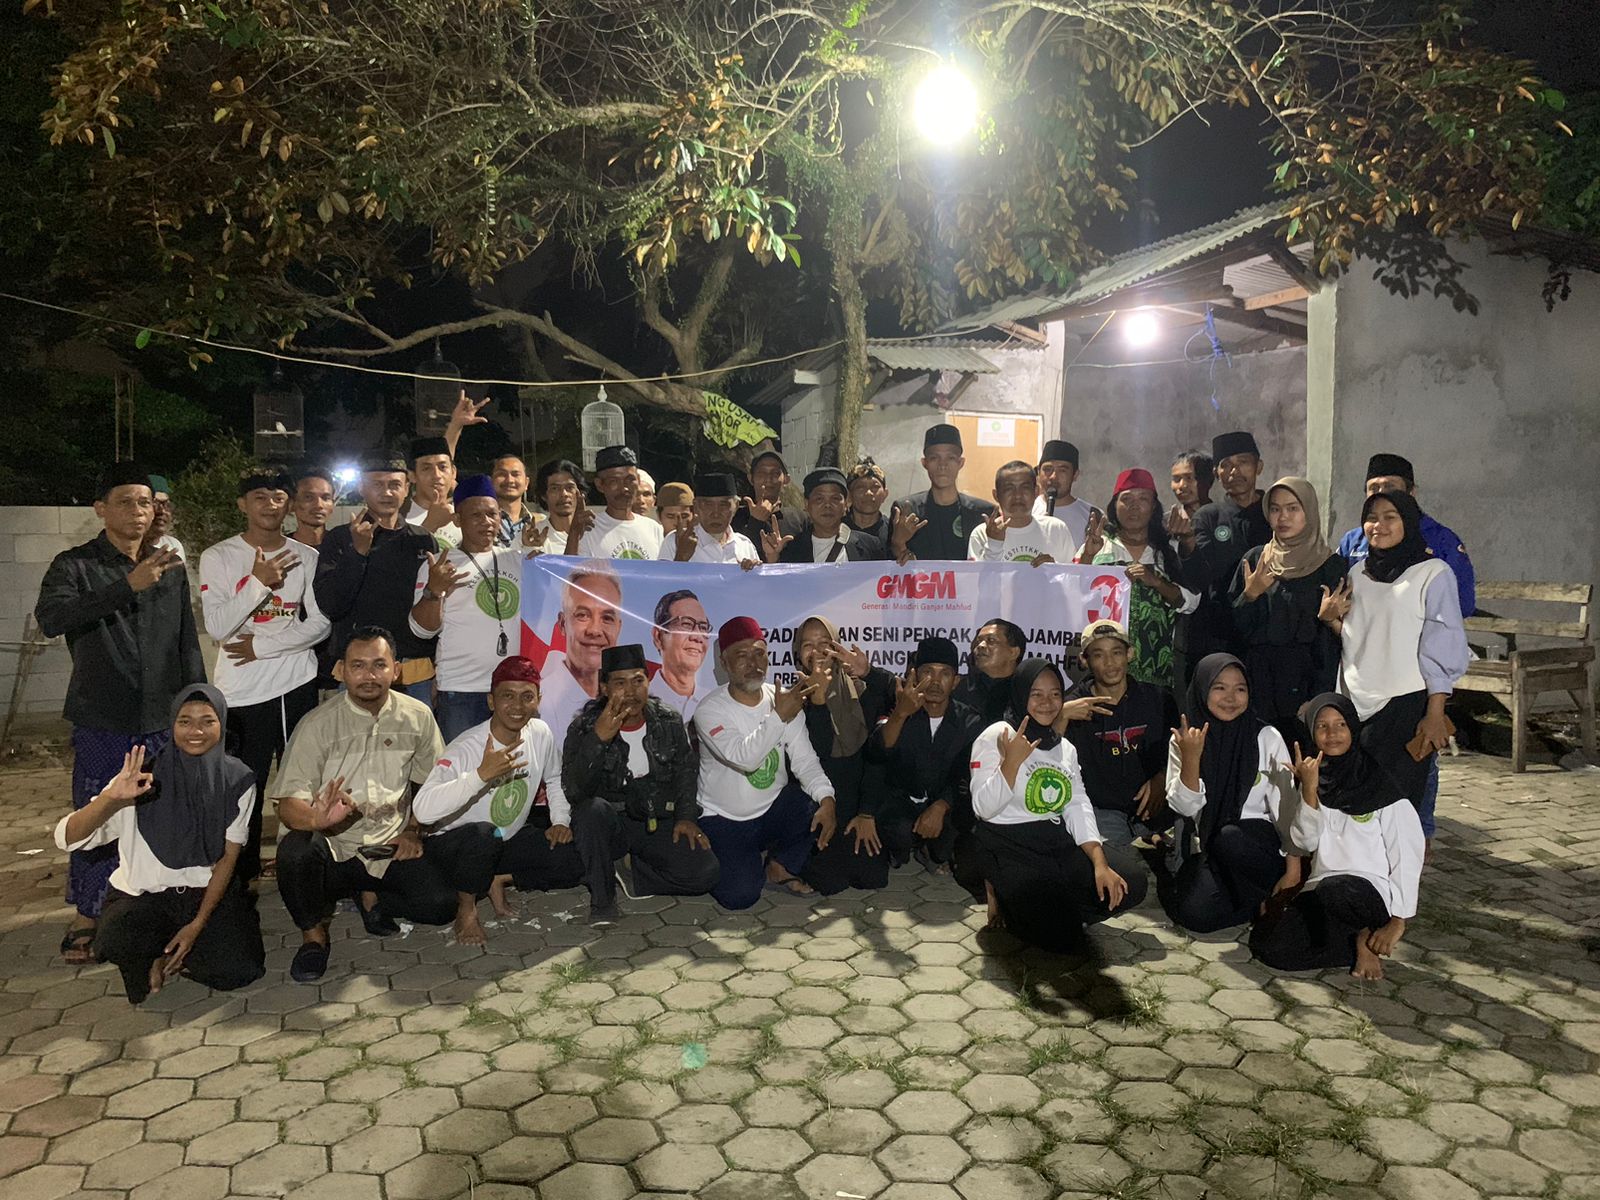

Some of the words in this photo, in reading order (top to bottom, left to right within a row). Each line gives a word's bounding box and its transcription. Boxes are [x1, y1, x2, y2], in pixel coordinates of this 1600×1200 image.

[877, 571, 956, 599] GMGM
[893, 602, 919, 611] Mandiri
[920, 602, 943, 612] Ganjar
[945, 603, 972, 611] Mahfud
[1087, 574, 1123, 624] 3
[863, 626, 898, 642] SENI
